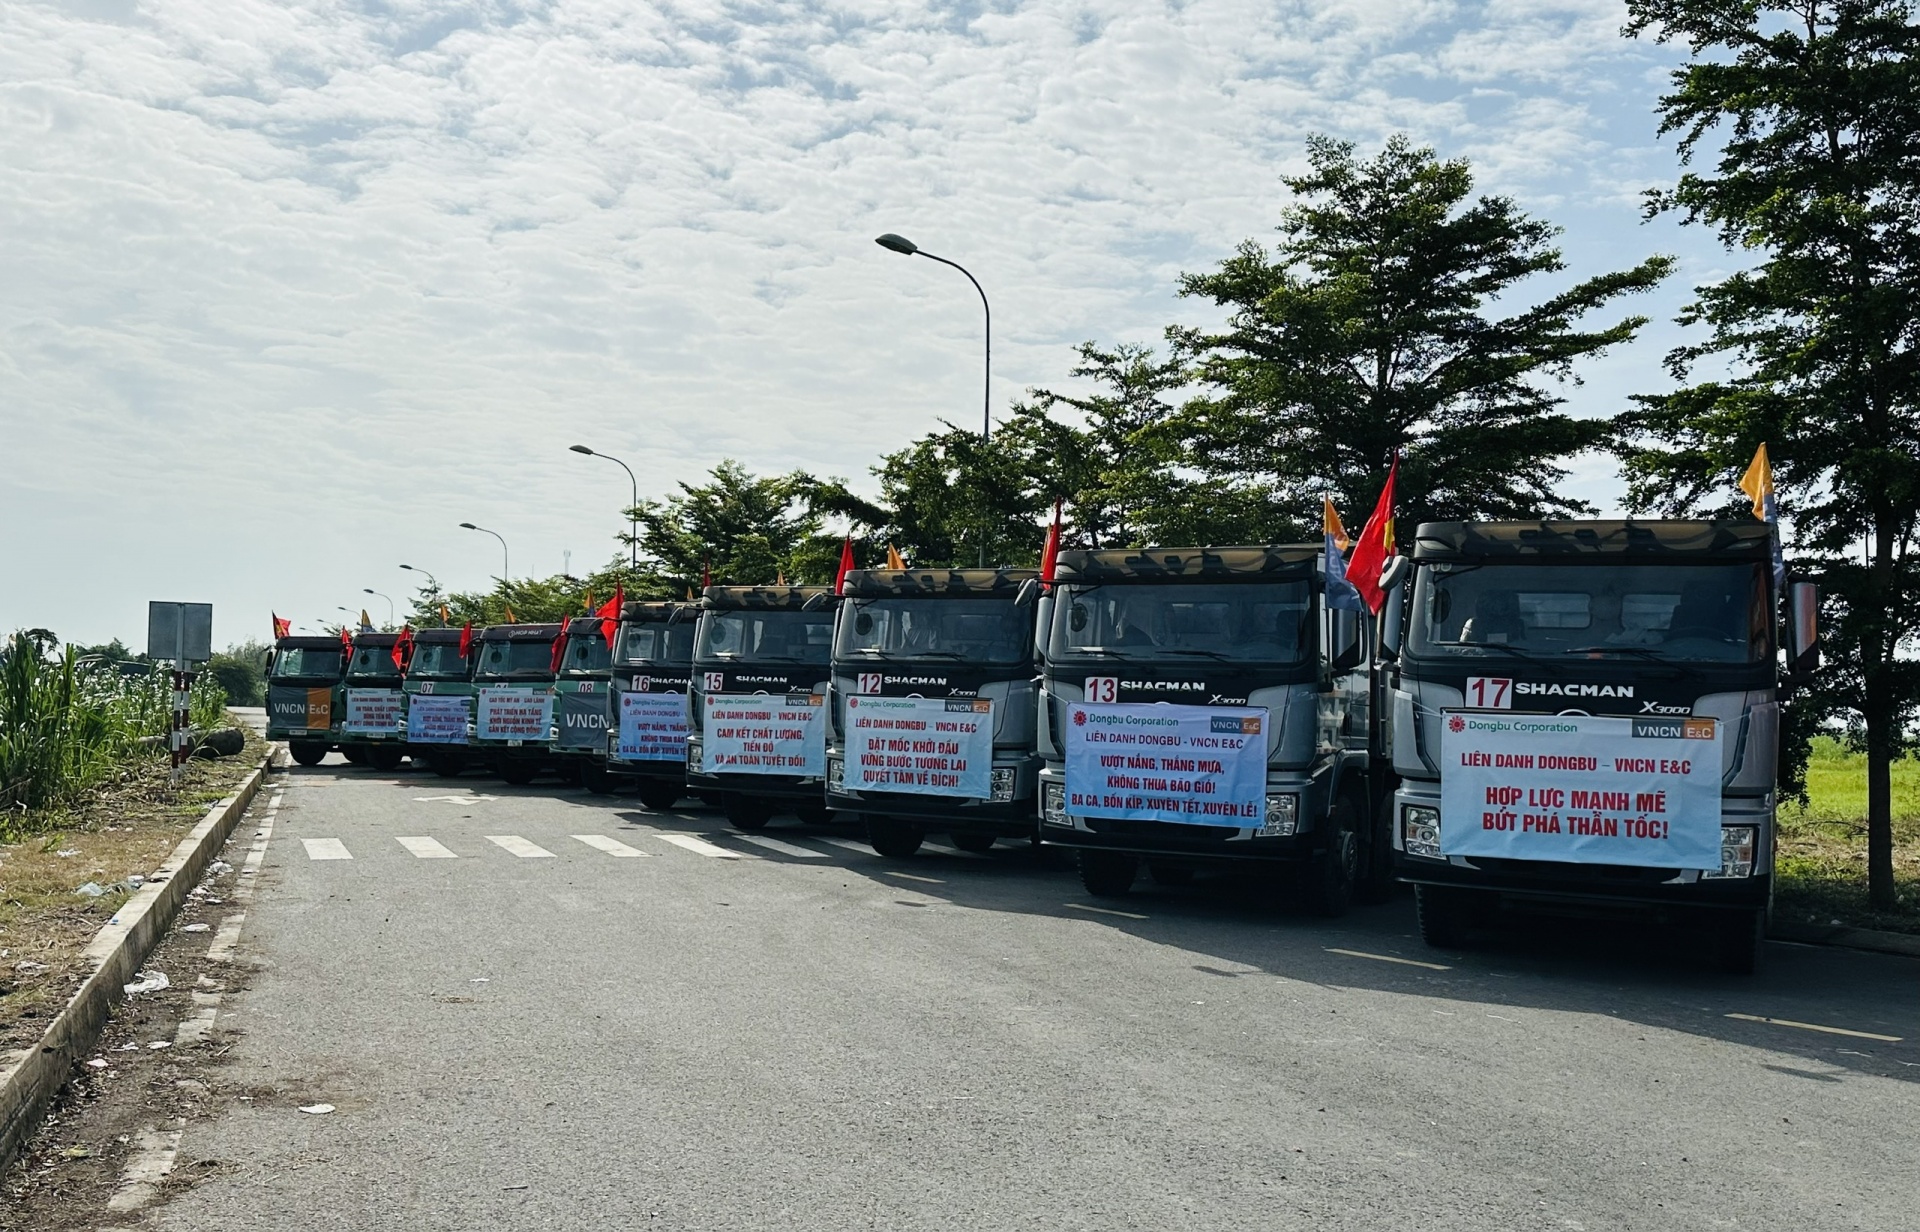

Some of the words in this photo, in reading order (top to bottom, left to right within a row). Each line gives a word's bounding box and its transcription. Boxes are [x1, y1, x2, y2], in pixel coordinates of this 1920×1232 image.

[634, 676, 648, 691] 16
[650, 677, 690, 685] SHACMA
[706, 673, 722, 690] 15
[735, 675, 788, 683] SHACMAN
[861, 674, 880, 693] 12
[884, 676, 947, 685] SHACMAN
[1120, 681, 1205, 691] SHACMAN
[422, 683, 433, 693] 07
[581, 683, 592, 692] 08
[1089, 678, 1115, 703] 13
[1472, 678, 1510, 708] 17
[1515, 682, 1634, 698] SHACMAN
[274, 703, 305, 714] VNCN
[310, 704, 328, 714] E&C
[883, 701, 916, 709] Corporation
[947, 704, 972, 712] VNCN
[1639, 701, 1691, 714] X3000
[566, 713, 610, 728] VNCN
[712, 710, 725, 719] LIÊN
[727, 711, 744, 720] DANH
[745, 711, 771, 720] DONGBU
[778, 712, 796, 721] VNCN
[798, 712, 812, 722] E&C
[1089, 713, 1124, 725] Dongbu
[1126, 715, 1179, 727] Corporation
[855, 716, 871, 728] LIÊN
[873, 719, 893, 729] DANH
[896, 720, 926, 731] DONGBU
[935, 722, 957, 732] VNCN
[960, 723, 976, 733] E&C
[1212, 721, 1239, 729] VNCN
[1243, 722, 1259, 730] E&C
[1469, 720, 1511, 733] Dongbu
[1513, 721, 1578, 733] Corporation
[1638, 726, 1681, 737] VNCN
[1687, 727, 1711, 738] E&C
[717, 728, 734, 739] CAM
[736, 726, 751, 739] KẾT
[752, 726, 773, 739] CHẤT
[775, 729, 805, 741] LƯỢNG,
[1086, 730, 1107, 743] LIÊN
[1109, 733, 1136, 744] DANH
[1139, 735, 1181, 746] DONGBU
[1190, 737, 1218, 748] VNCN
[1222, 739, 1244, 749] E&C
[743, 740, 760, 752] TIẾN
[868, 737, 886, 753] ĐẶT
[888, 736, 910, 752] MỐC
[912, 738, 935, 754] KHỞI
[715, 752, 724, 764] VÀ
[725, 755, 737, 765] AN
[739, 753, 760, 765] TOÀN
[762, 754, 786, 768] TUYỆT
[788, 754, 805, 767] ĐỐI!
[860, 752, 884, 767] VỮNG
[886, 754, 912, 769] BƯỚC
[915, 757, 948, 771] TƯƠNG
[950, 759, 967, 772] LAI
[1101, 755, 1125, 770] VƯỢT
[1127, 753, 1158, 771] NẮNG,
[1161, 755, 1194, 772] THẮNG
[1198, 760, 1224, 775] MƯA,
[1461, 750, 1491, 767] LIÊN
[1495, 754, 1533, 769] DANH
[1538, 755, 1597, 771] DONGBU
[1615, 758, 1655, 773] VNCN
[1660, 760, 1691, 775] E&C
[863, 767, 891, 783] QUYẾT
[893, 770, 914, 785] TÂM
[917, 770, 928, 785] VỀ
[931, 772, 959, 788] ĐÍCH!
[1107, 774, 1139, 790] KHÔNG
[1142, 778, 1167, 791] THUA
[1170, 778, 1191, 792] BÃO
[1194, 779, 1215, 794] GIÓ!
[1072, 793, 1083, 806] BA
[1086, 794, 1101, 808] CA,
[1104, 792, 1123, 809] BỐN
[1125, 795, 1144, 810] KÍP,
[1147, 797, 1179, 812] XUYÊN
[1203, 801, 1238, 816] XUYÊN
[1241, 801, 1257, 817] LỄ!
[1486, 786, 1523, 810] HỢP
[1529, 787, 1564, 811] LỰC
[1571, 790, 1630, 813] MẠNH
[1636, 790, 1666, 813] MẼ
[1483, 807, 1518, 831] BỨT
[1523, 812, 1561, 834] PHÁ
[1567, 812, 1617, 837] THẦN
[1624, 813, 1669, 839] TỐC!
